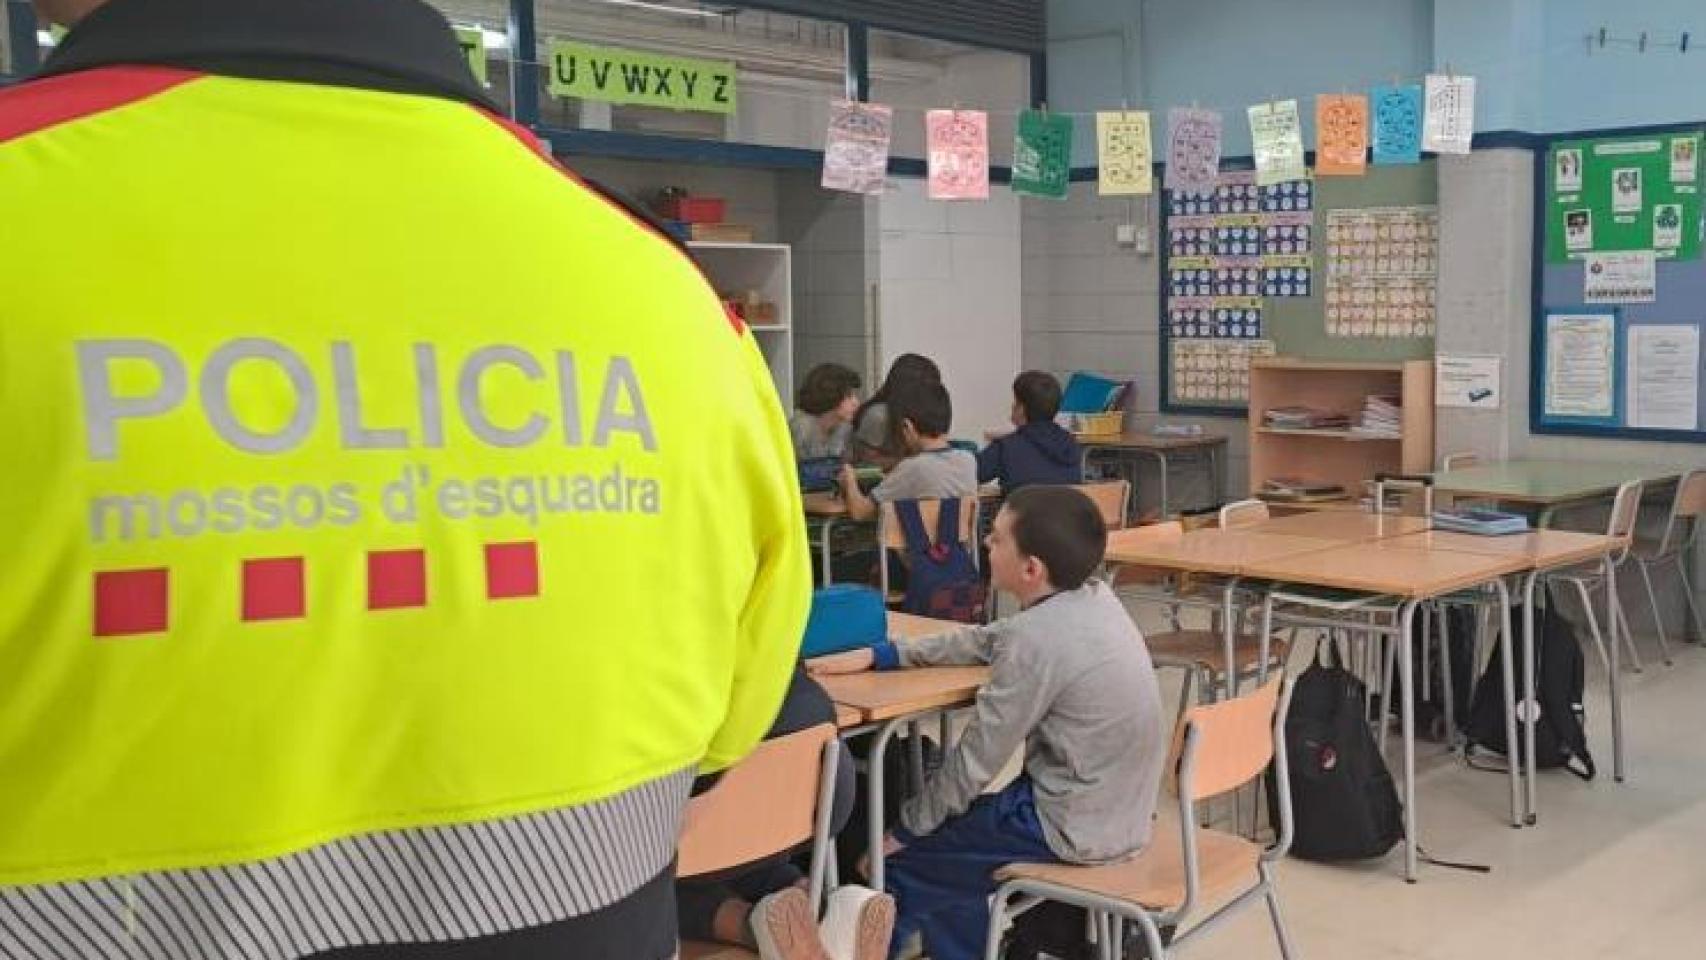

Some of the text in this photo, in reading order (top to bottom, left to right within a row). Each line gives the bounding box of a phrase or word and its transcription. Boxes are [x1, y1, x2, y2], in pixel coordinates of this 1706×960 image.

[556, 54, 576, 85] U
[590, 59, 611, 90] V
[682, 70, 698, 99] Y
[713, 75, 730, 102] Z
[75, 337, 659, 462] POLICIA
[89, 463, 661, 543] mossos d'esquadra
